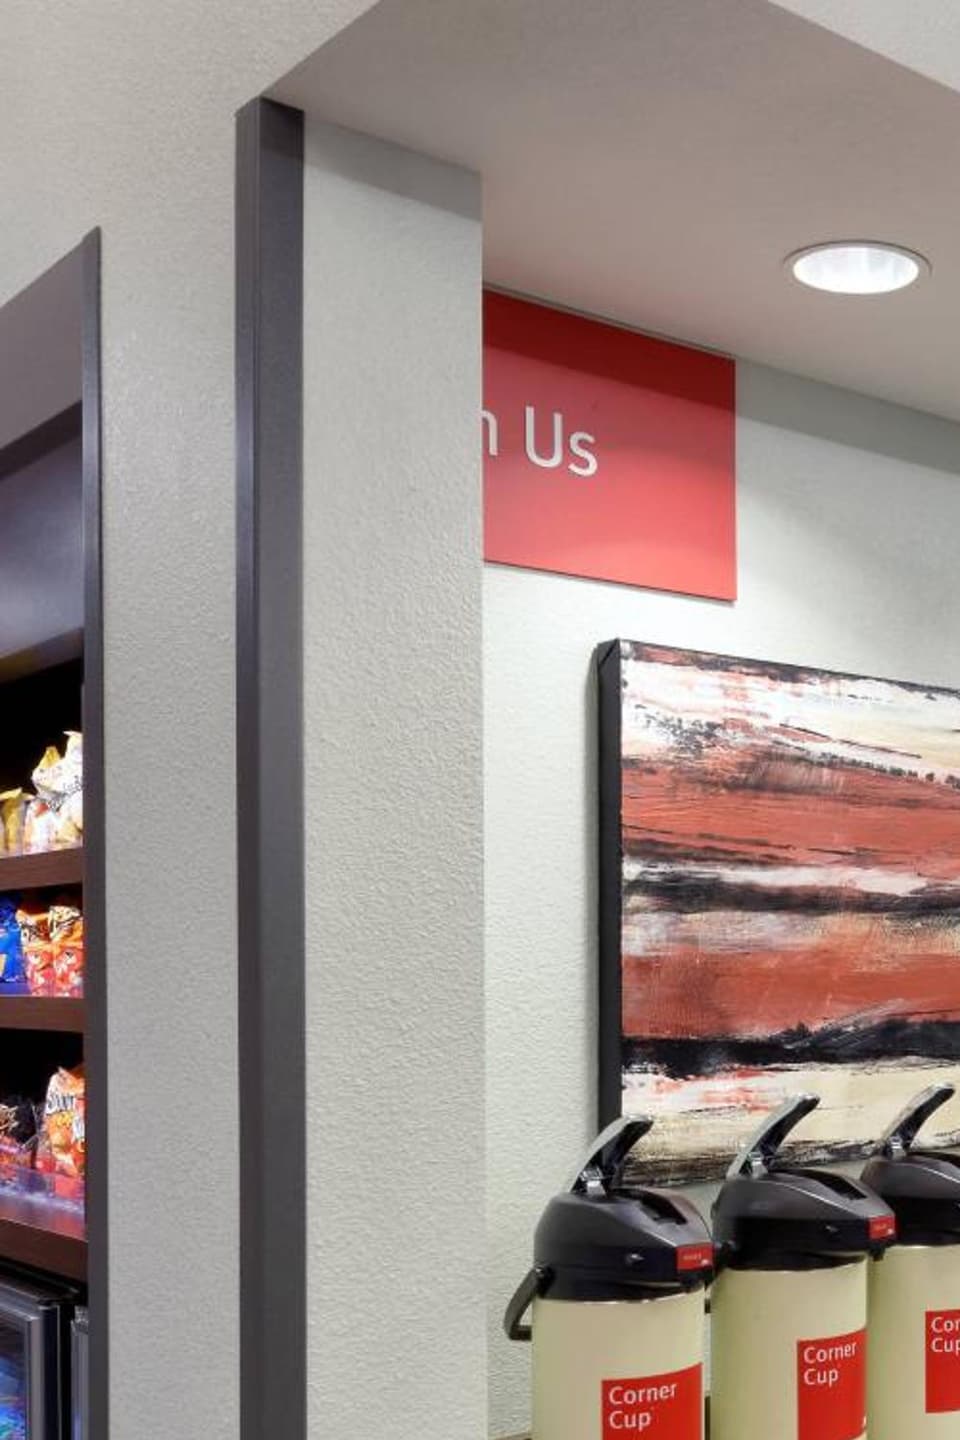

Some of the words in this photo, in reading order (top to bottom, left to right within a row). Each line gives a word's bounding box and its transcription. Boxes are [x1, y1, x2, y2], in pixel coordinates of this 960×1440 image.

[525, 405, 598, 477] Us
[803, 1342, 857, 1364] Corner
[803, 1368, 839, 1388] Cup
[608, 1384, 677, 1405] Corner
[608, 1410, 651, 1432] Cup
